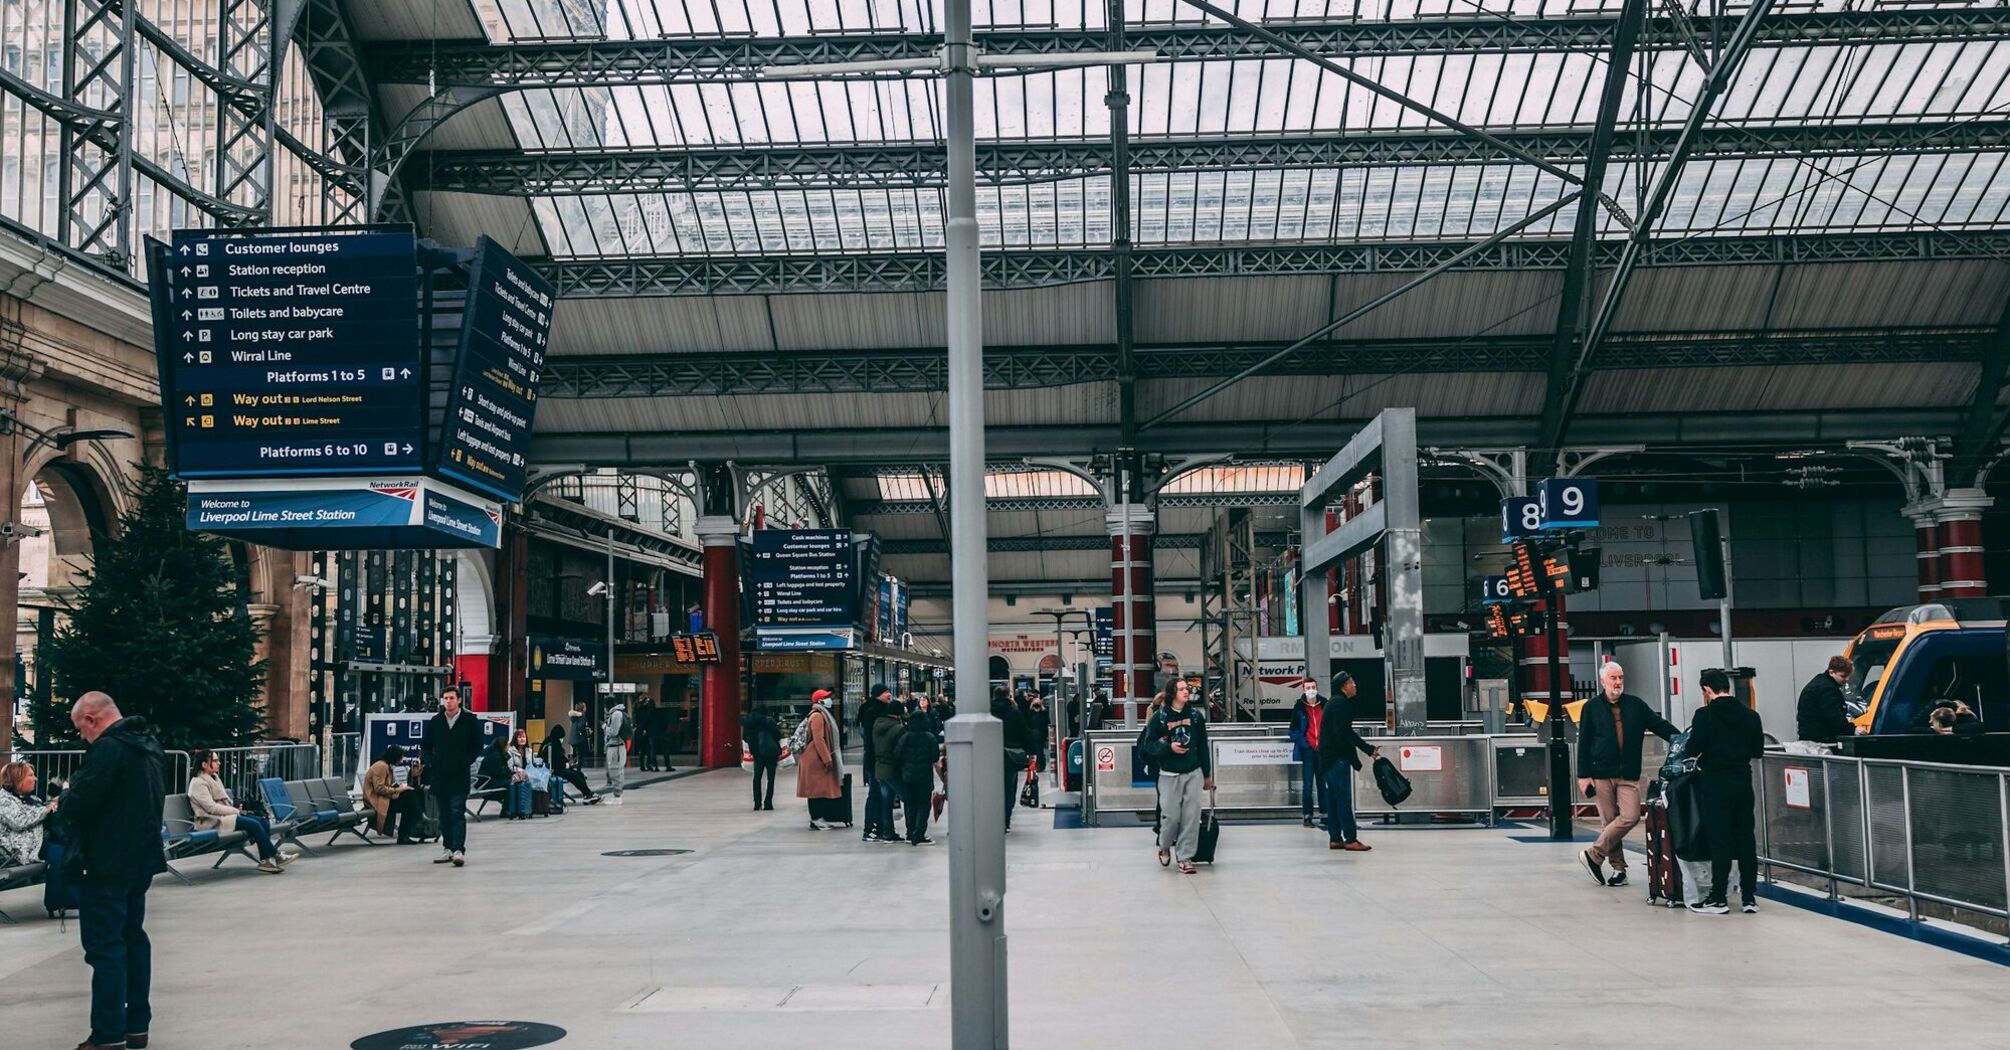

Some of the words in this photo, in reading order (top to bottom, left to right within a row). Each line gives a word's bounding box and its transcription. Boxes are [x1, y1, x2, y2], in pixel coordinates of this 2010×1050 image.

[225, 244, 286, 254] Customer
[290, 242, 339, 255] lounges
[229, 265, 270, 276] Station
[272, 264, 326, 277] reception
[230, 286, 266, 297] Tickets
[270, 285, 293, 296] and
[297, 284, 329, 296] Travel
[332, 284, 371, 295] Centre
[230, 308, 267, 319] Toilets
[270, 307, 290, 318] and
[293, 307, 344, 321] babycare
[231, 330, 259, 342] Long
[262, 330, 285, 343] stay
[288, 331, 306, 340] car
[308, 328, 333, 342] park
[231, 351, 266, 362] Wirral
[268, 350, 292, 361] Line
[267, 370, 329, 383] Platforms
[332, 370, 337, 381] 1
[340, 371, 354, 381] to
[358, 370, 366, 380] 5
[233, 394, 259, 406] Way
[262, 394, 283, 404] out
[233, 416, 259, 428] Way
[262, 415, 283, 425] out
[260, 446, 322, 458] Platforms
[324, 446, 333, 456] 6
[336, 446, 350, 456] to
[353, 444, 368, 455] 10
[201, 500, 239, 509] Welcome
[240, 500, 250, 508] to
[1540, 489, 1546, 518] 9
[1562, 486, 1584, 516] 9
[200, 510, 251, 525] Liverpool
[252, 510, 279, 521] Lime
[280, 510, 315, 521] Street
[316, 509, 356, 521] Station
[1502, 506, 1508, 532] 8
[1522, 504, 1539, 530] 8
[1633, 526, 1655, 539] TO
[1496, 579, 1508, 596] 6
[991, 640, 1020, 648] NORTH
[1243, 666, 1294, 676] Ntwork
